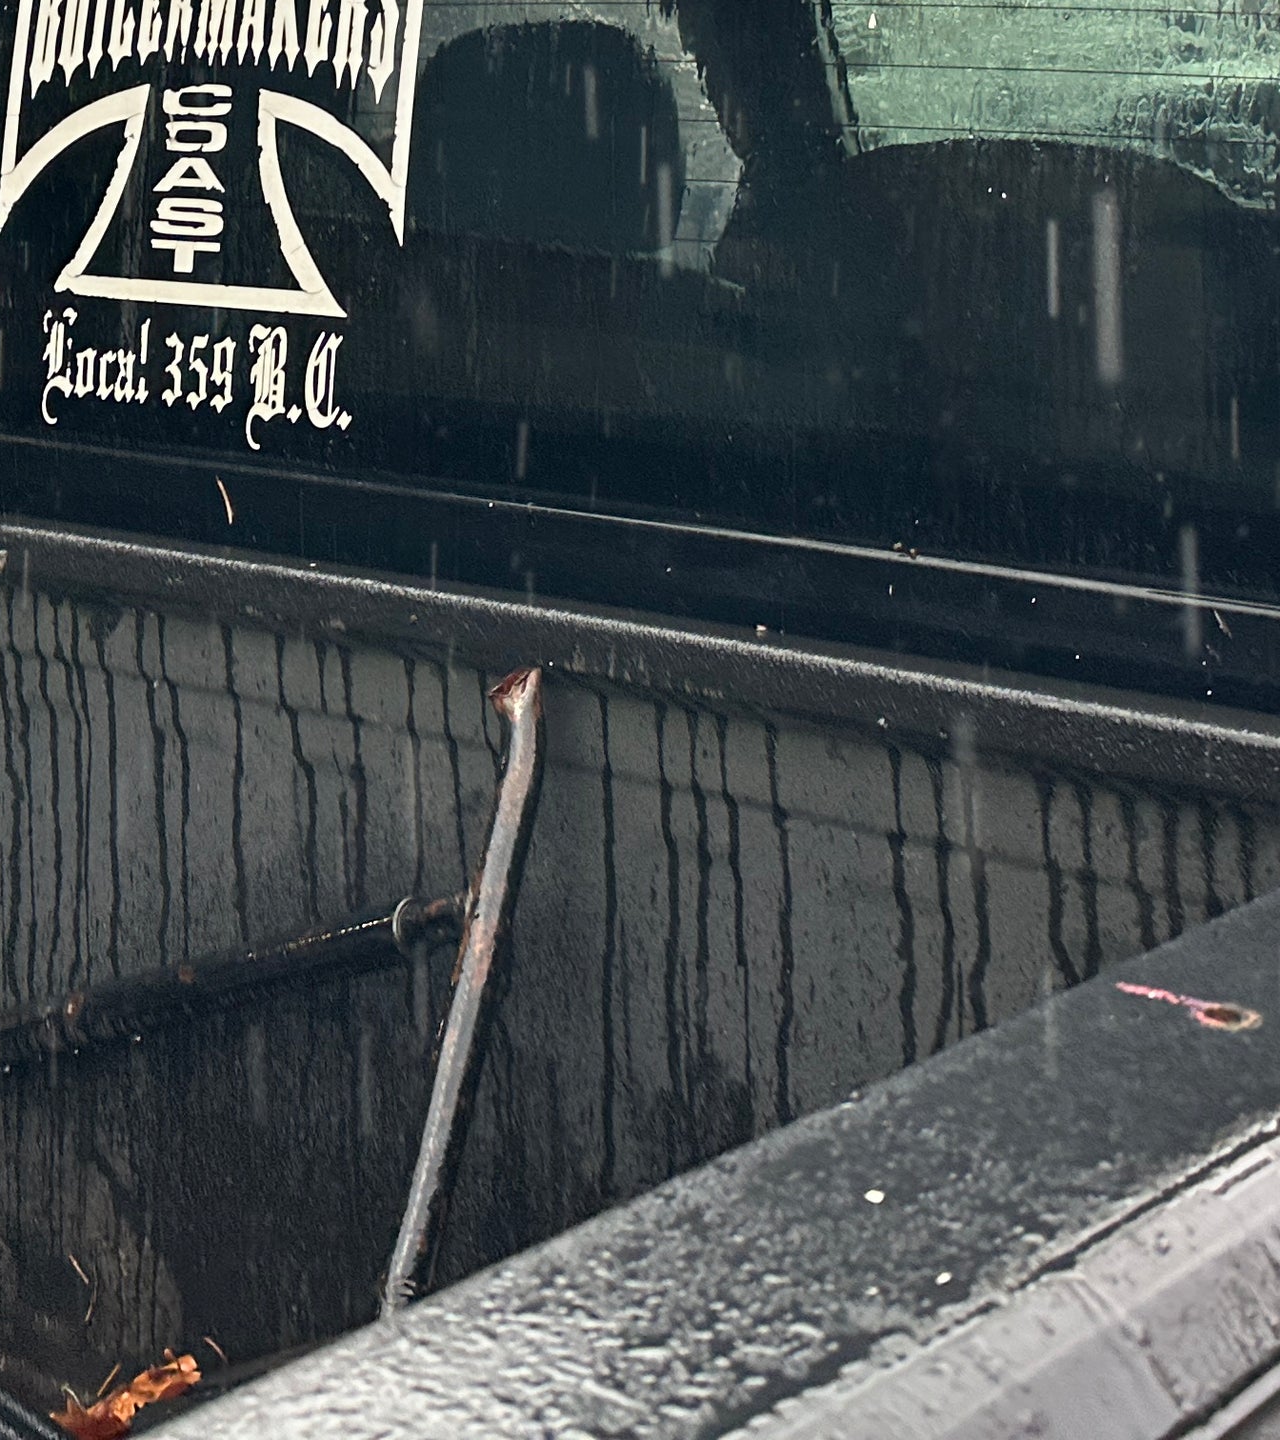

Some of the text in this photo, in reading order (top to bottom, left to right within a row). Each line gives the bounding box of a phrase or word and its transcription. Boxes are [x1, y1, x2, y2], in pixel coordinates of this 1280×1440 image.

[151, 85, 232, 273] COAST
[41, 307, 353, 451] Local 359 B.C.
